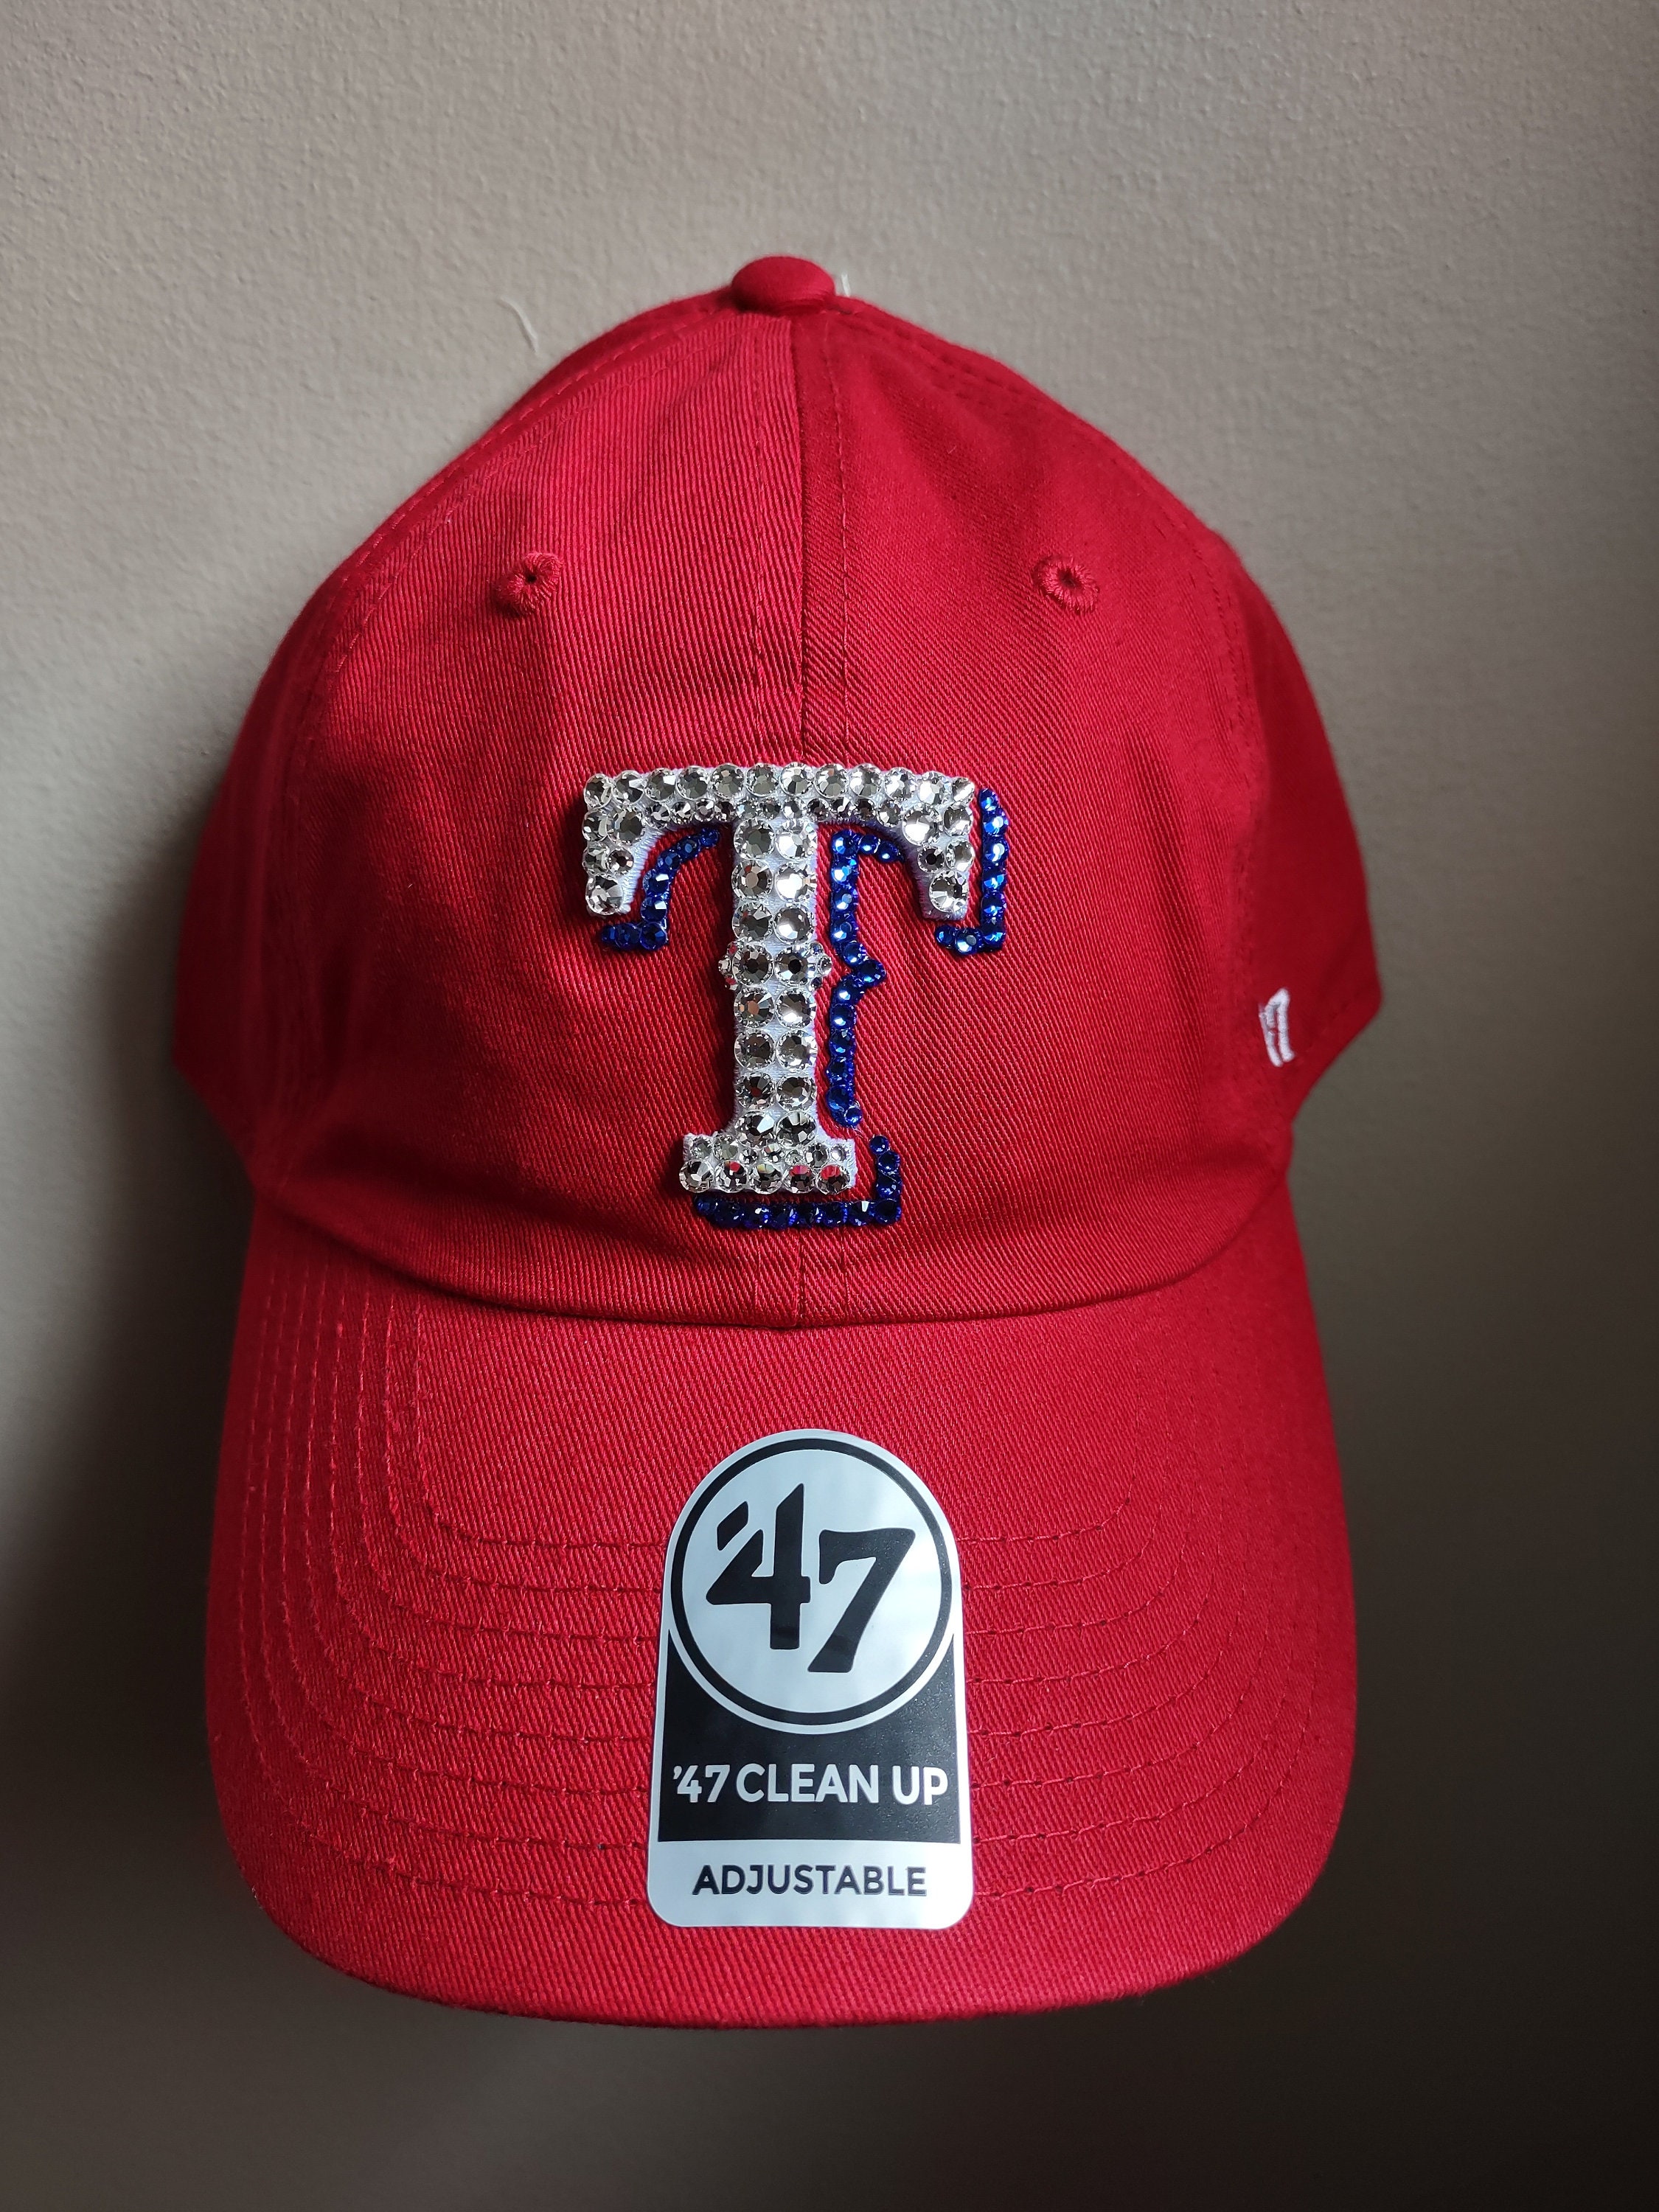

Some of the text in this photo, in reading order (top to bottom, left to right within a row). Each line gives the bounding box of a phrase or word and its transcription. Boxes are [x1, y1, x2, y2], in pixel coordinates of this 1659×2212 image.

[582, 762, 976, 1194] T
[672, 1763, 949, 1806] '47 CLEAN UP
[691, 1864, 928, 1898] ADJUSTABLE
